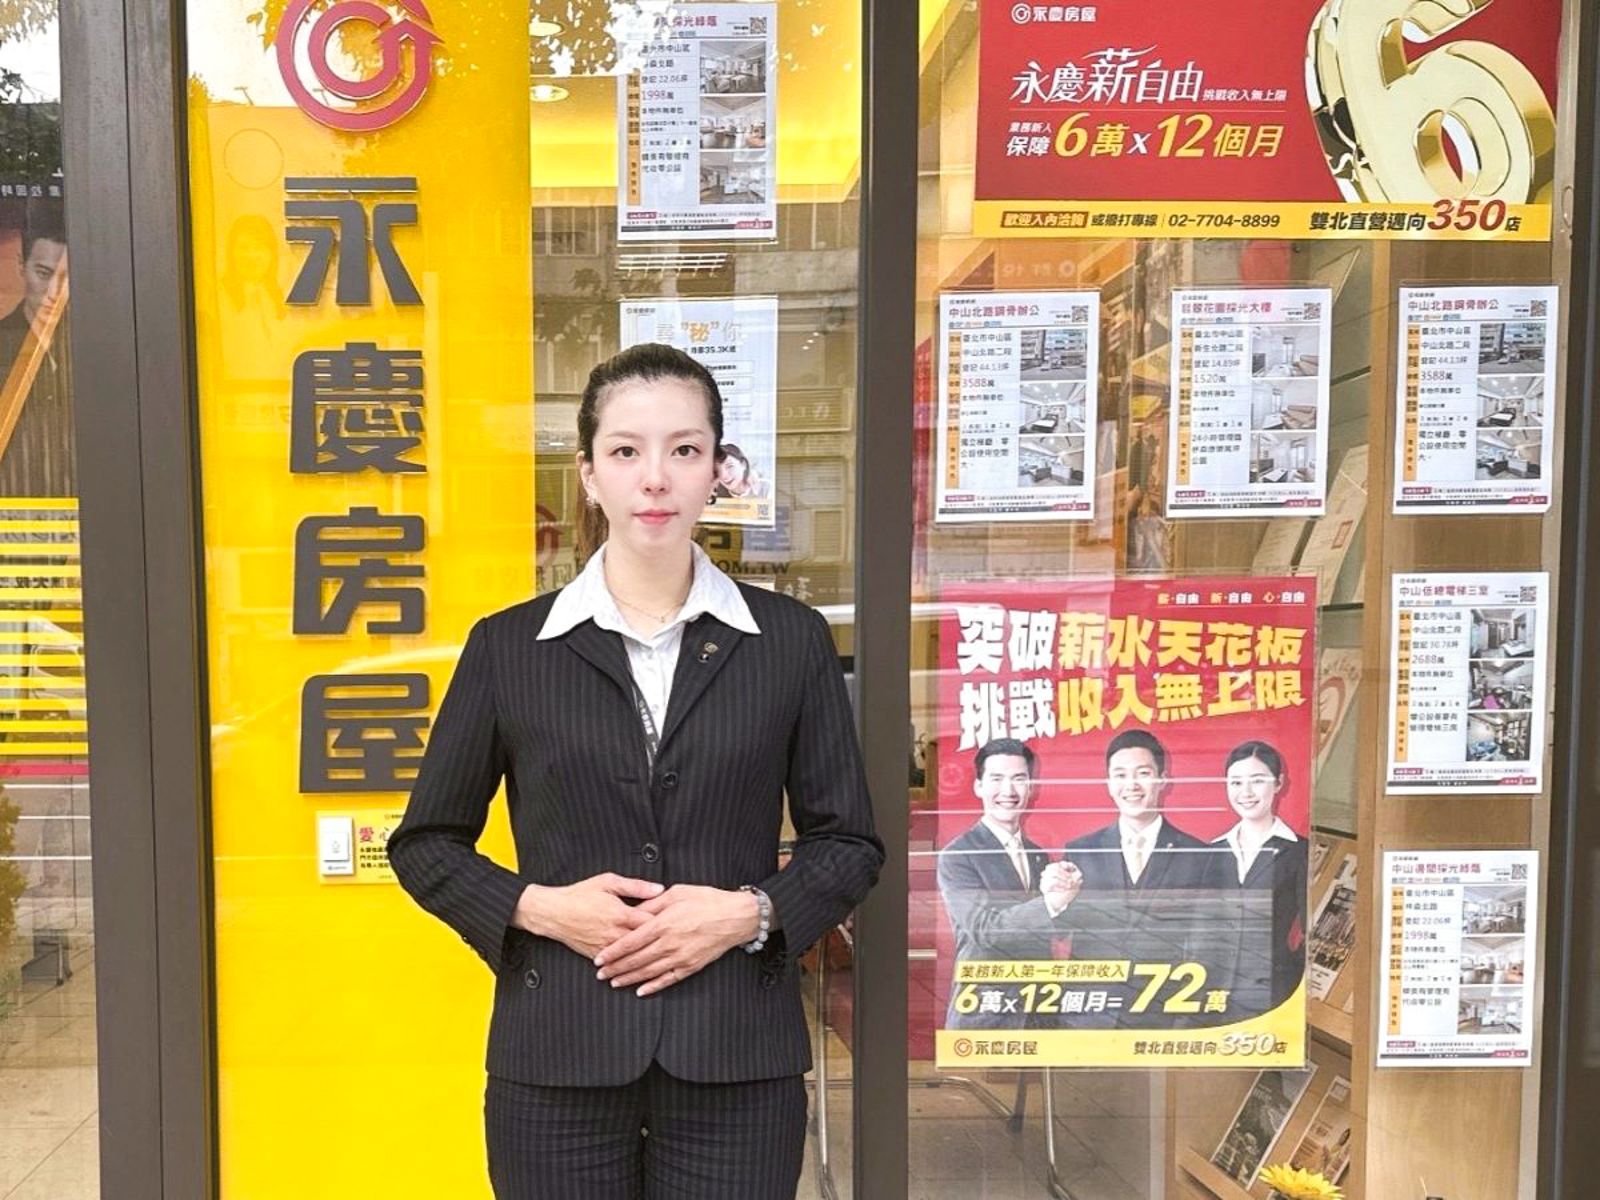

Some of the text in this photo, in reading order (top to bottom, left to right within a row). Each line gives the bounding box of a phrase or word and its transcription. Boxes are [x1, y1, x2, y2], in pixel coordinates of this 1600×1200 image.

[1033, 6, 1097, 23] 永慶房屋
[1009, 44, 1288, 105] 永慶薪自由 挑戰收入無上限
[1168, 213, 1281, 228] 02-7704-8899
[1309, 199, 1522, 231] 雙北直營邁向350店
[962, 378, 995, 388] 3588萬
[1420, 370, 1453, 380] 3588萬
[284, 176, 434, 793] 永慶房屋
[955, 604, 1309, 676] 突破薪水天花板
[1411, 655, 1445, 664] 2688萬
[955, 669, 1307, 752] 挑戰收入無上限
[960, 963, 1126, 979] 業務新人第一年保障收入
[975, 1040, 1039, 1056] 永慶房屋
